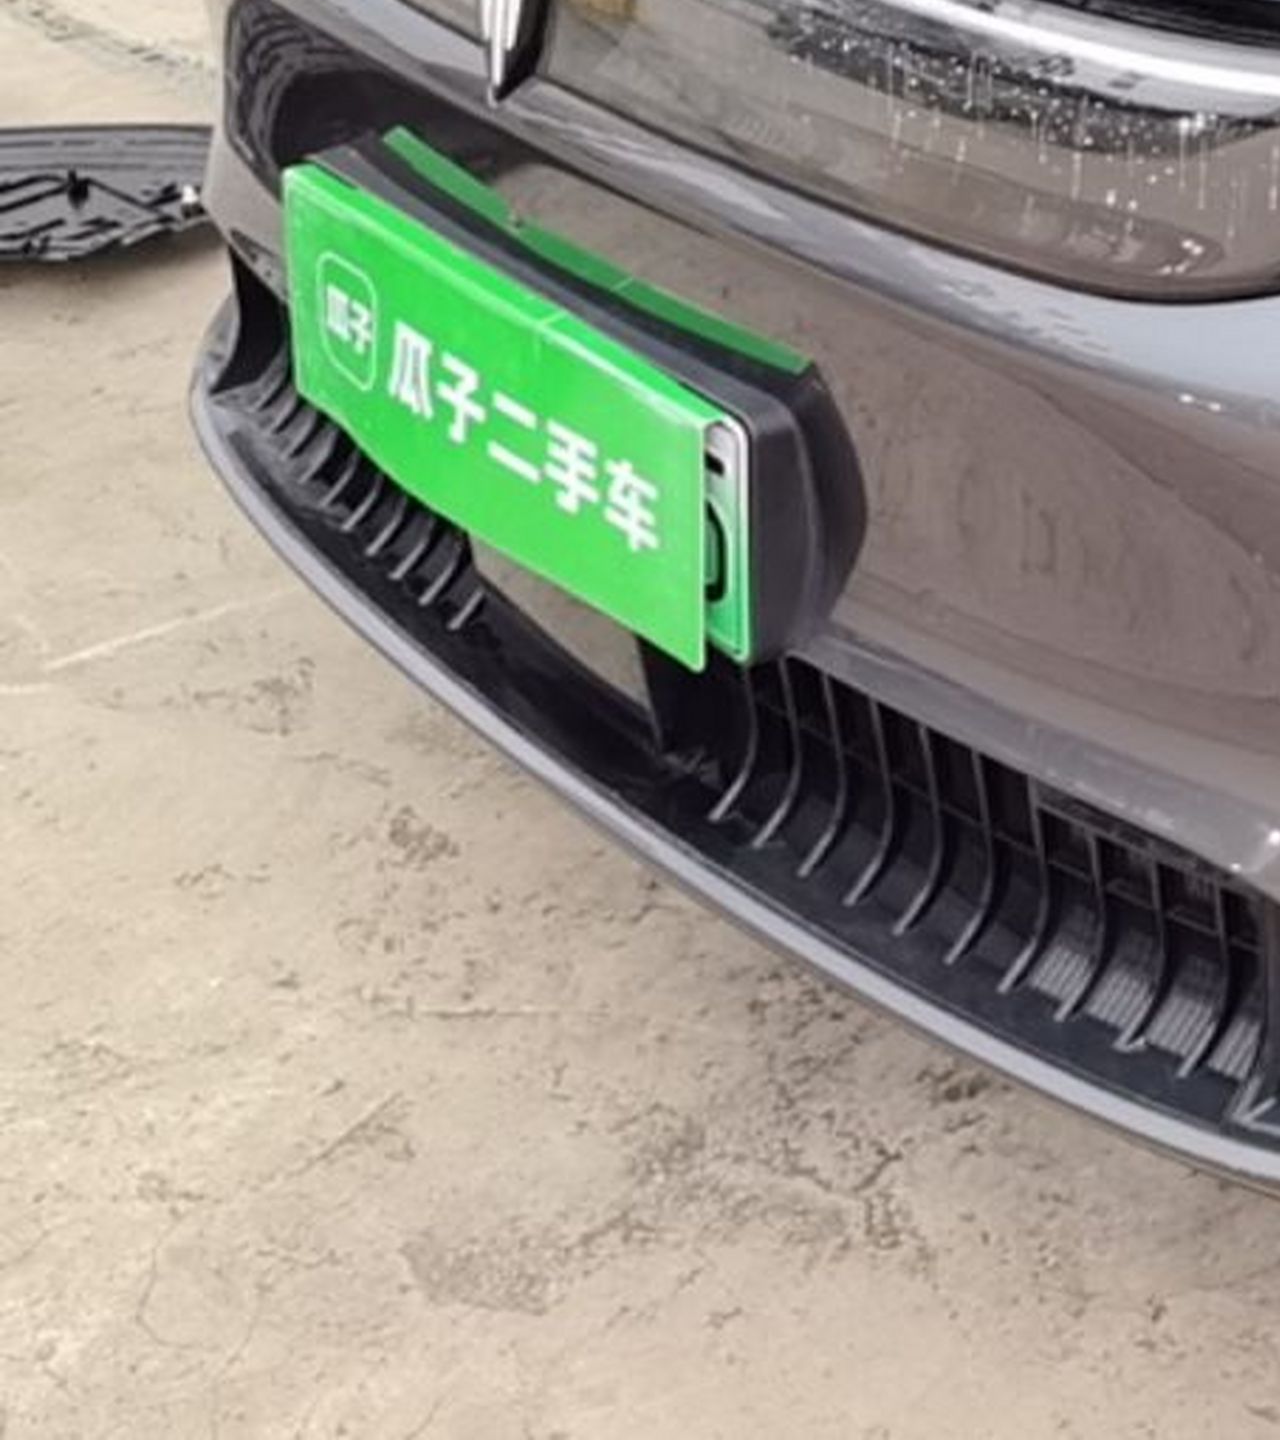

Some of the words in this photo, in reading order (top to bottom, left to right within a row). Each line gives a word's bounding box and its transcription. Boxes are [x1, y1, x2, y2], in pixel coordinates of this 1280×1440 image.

[325, 283, 372, 355] 瓜子
[387, 319, 659, 553] 瓜子二手车
